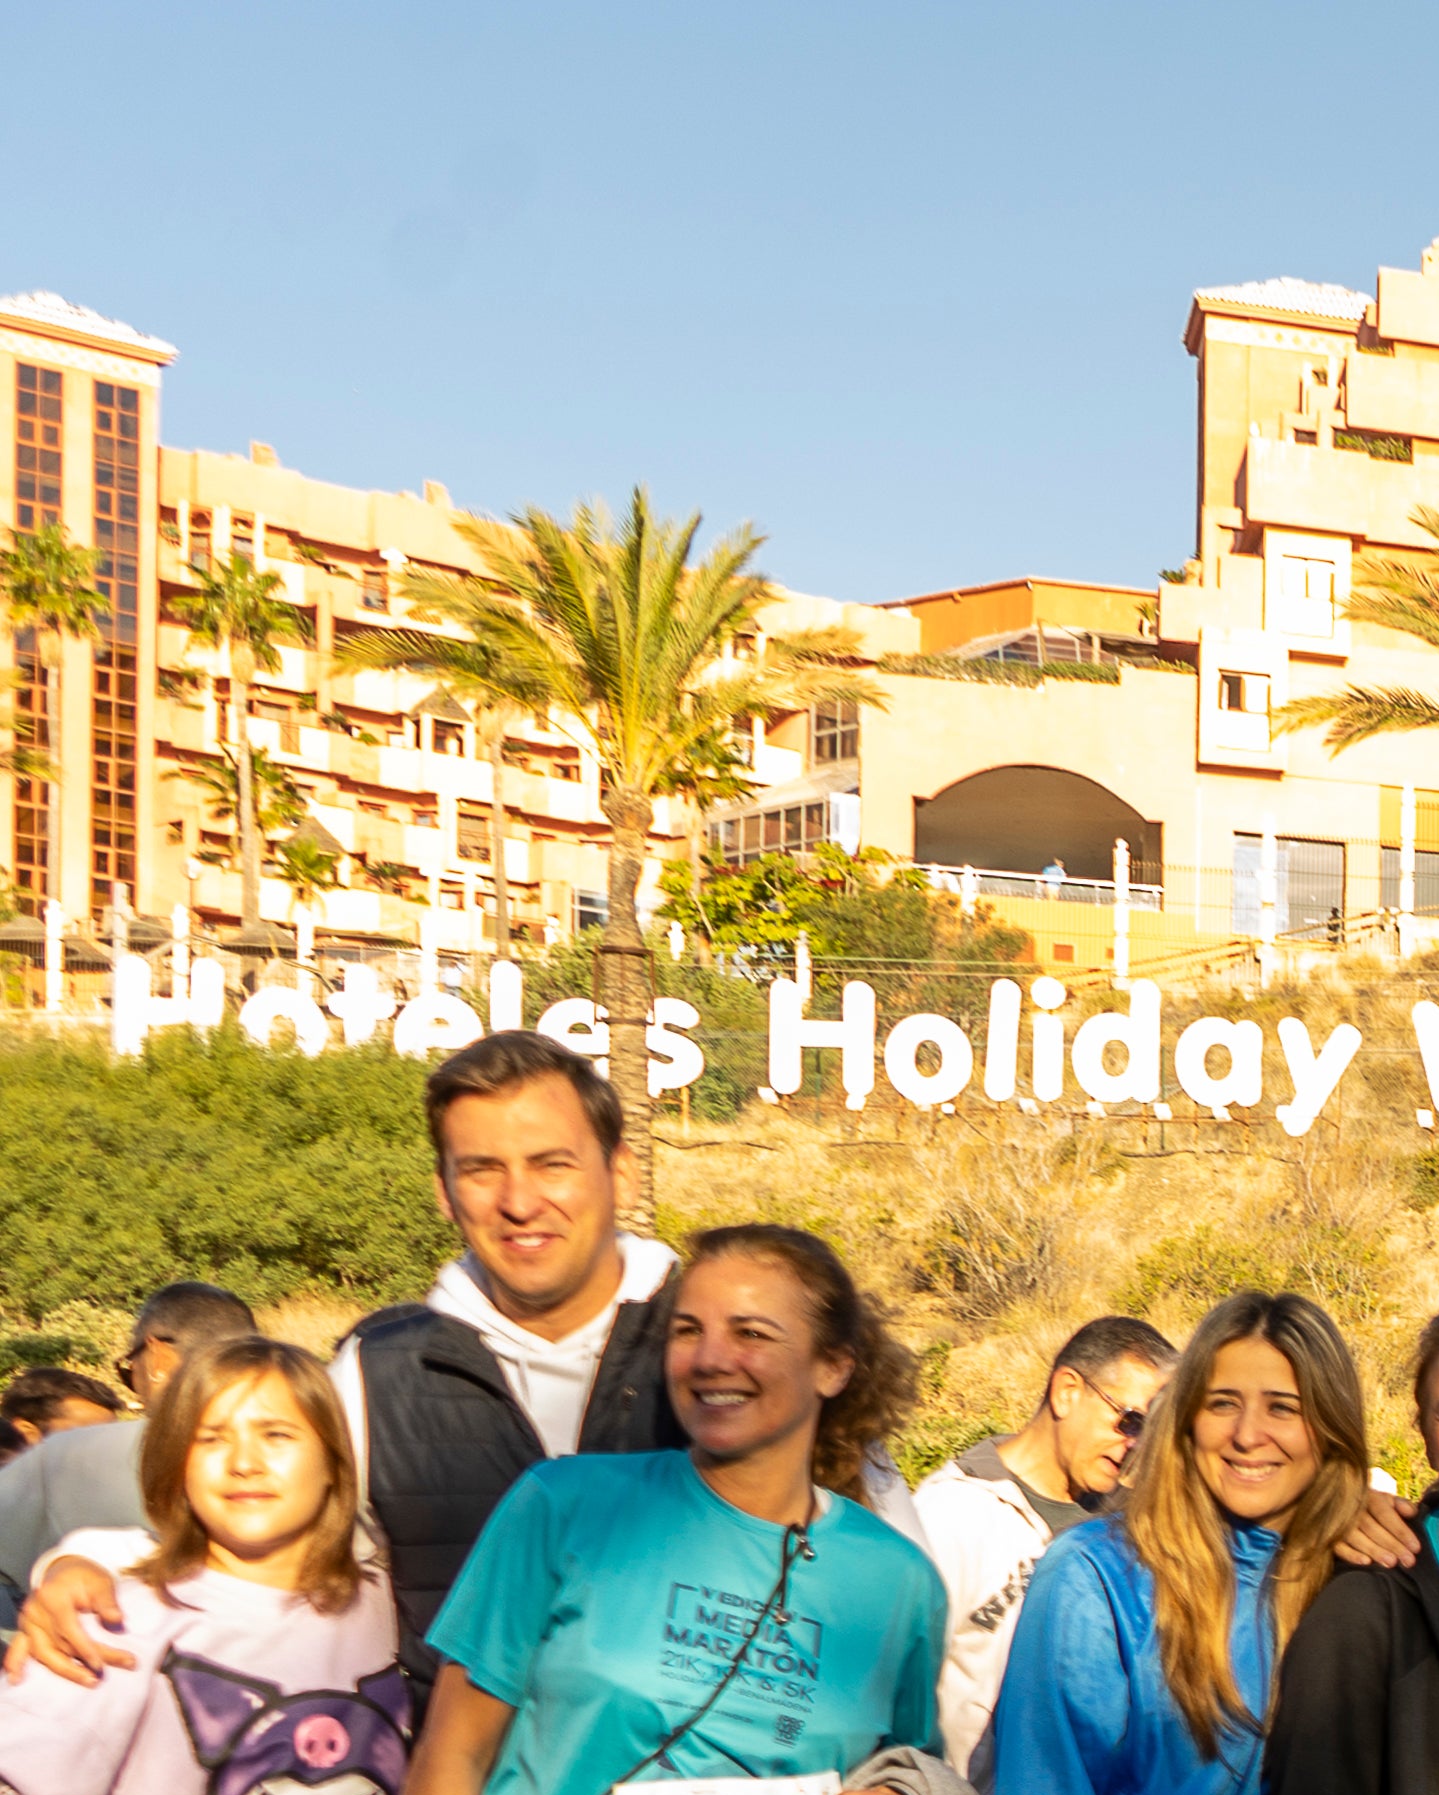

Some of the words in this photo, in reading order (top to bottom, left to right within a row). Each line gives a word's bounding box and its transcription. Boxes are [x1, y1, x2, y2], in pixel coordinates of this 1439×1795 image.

[113, 955, 705, 1093] Hoteles
[769, 977, 1361, 1134] Holiday
[696, 1605, 793, 1648] MEDIA
[664, 1623, 819, 1682] MARATÓN
[760, 1676, 776, 1692] &
[784, 1681, 816, 1704] 5K
